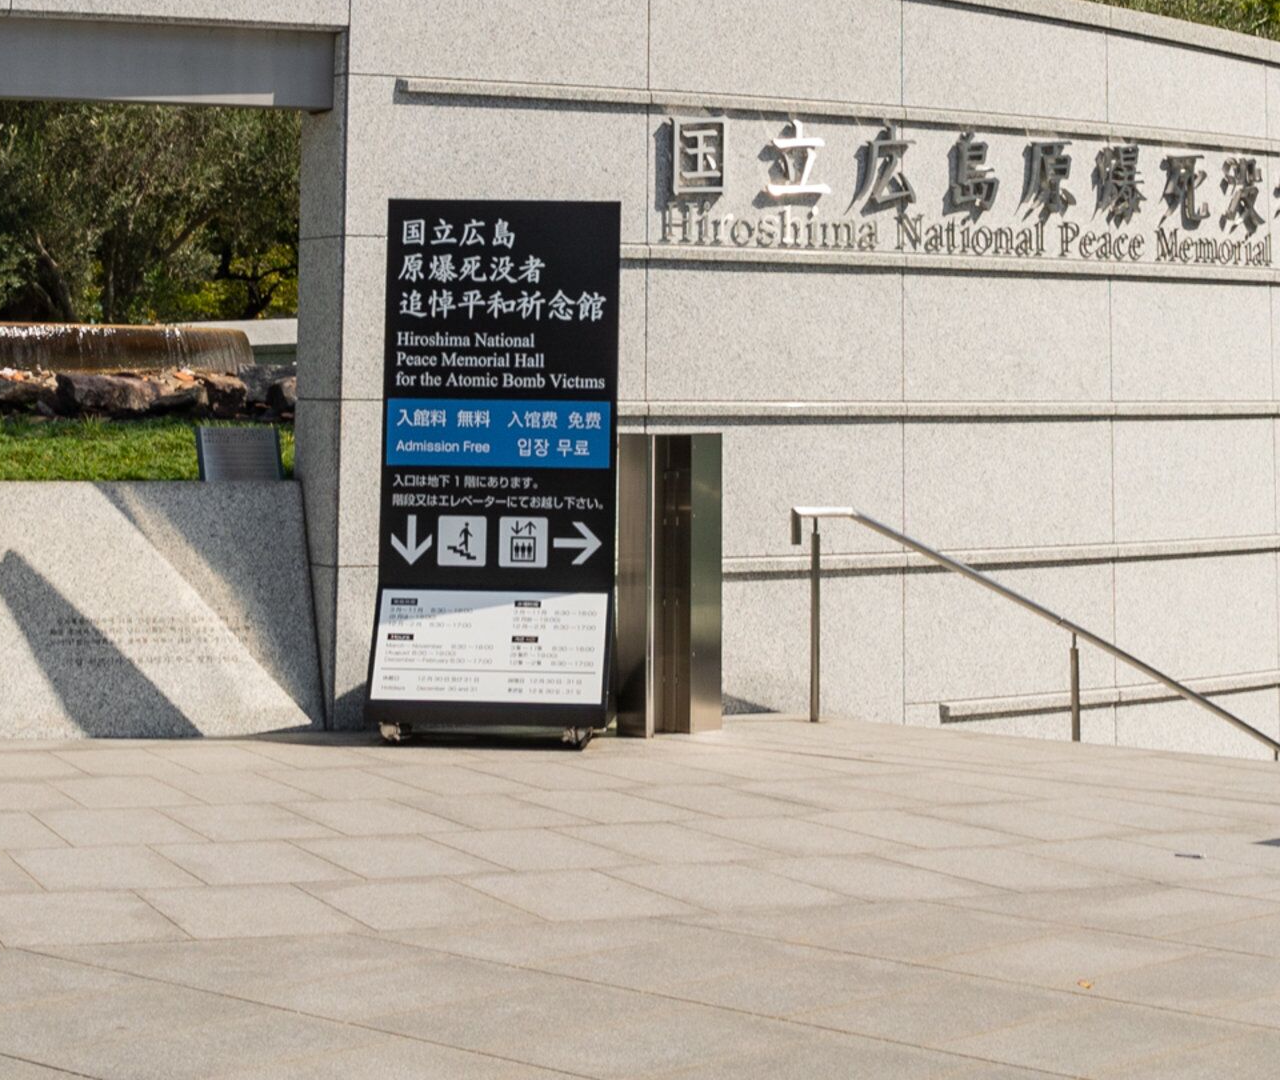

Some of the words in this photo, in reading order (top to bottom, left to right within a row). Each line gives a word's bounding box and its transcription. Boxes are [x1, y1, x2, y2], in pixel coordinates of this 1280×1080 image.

[401, 218, 516, 249] 国立広島
[660, 202, 878, 250] Hiroshima
[895, 213, 1046, 256] National
[1059, 222, 1144, 262] Peace
[1155, 227, 1272, 268] Memorial
[398, 253, 546, 284] 原爆死没者
[399, 289, 607, 322] 追悼平和祈念館
[396, 332, 471, 347] Hiroshima
[474, 333, 535, 348] National
[396, 352, 437, 367] Peace
[441, 352, 510, 368] Memorial
[514, 353, 545, 369] Hall
[395, 371, 417, 387] for
[420, 372, 442, 387] the
[445, 372, 498, 388] Atomic
[502, 373, 545, 389] Bomb
[549, 374, 606, 390] Victims
[396, 409, 447, 428] 入館料
[457, 409, 490, 428] 無料
[507, 411, 558, 429] 入馆费
[568, 411, 601, 430] 免费
[395, 440, 459, 453] Admission
[463, 441, 490, 453] Free
[517, 438, 550, 457] 입장
[557, 439, 590, 457] 무료
[392, 493, 604, 511] 階段又はエレベーターにてお越し下さい。
